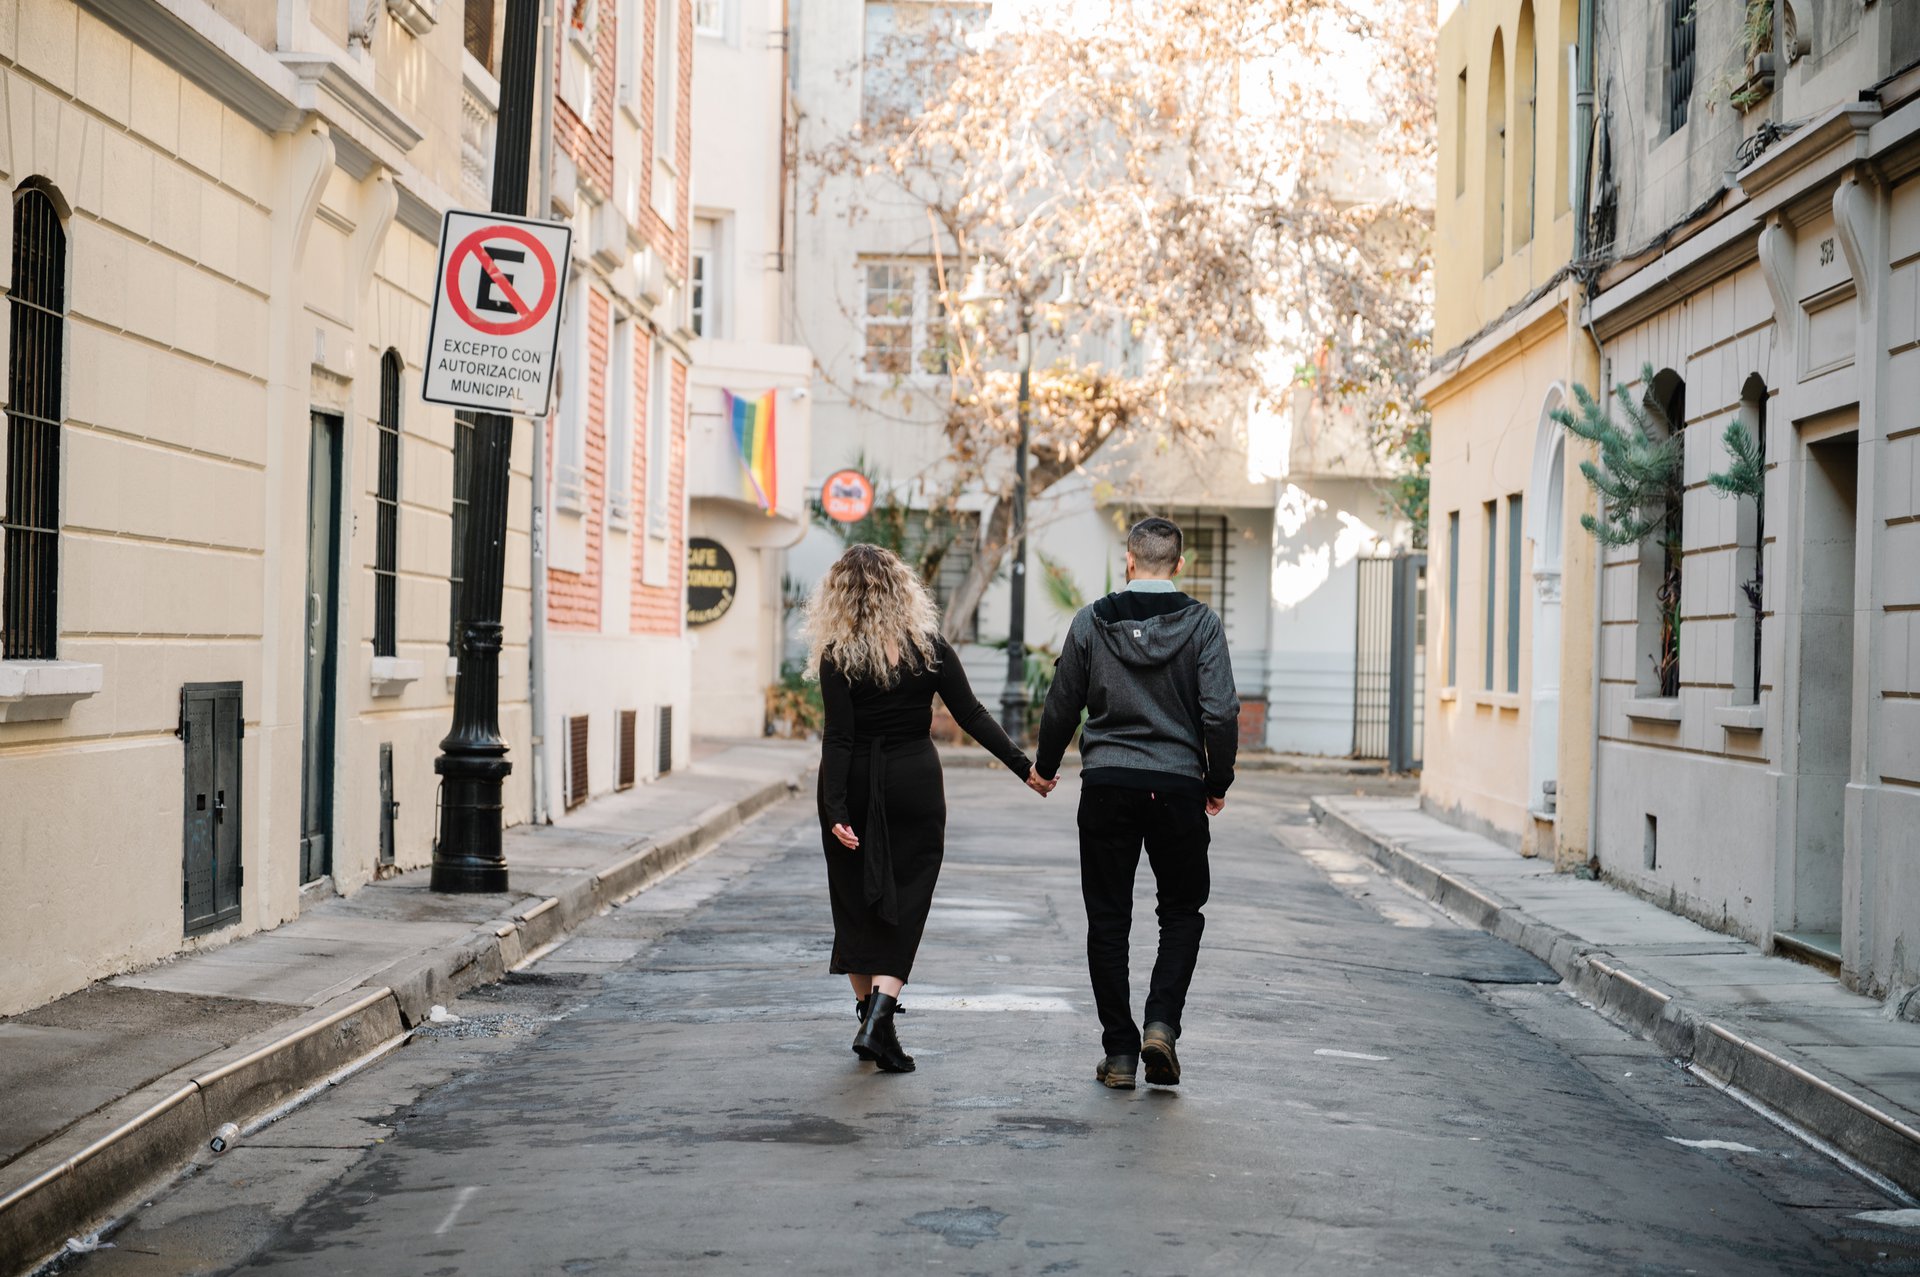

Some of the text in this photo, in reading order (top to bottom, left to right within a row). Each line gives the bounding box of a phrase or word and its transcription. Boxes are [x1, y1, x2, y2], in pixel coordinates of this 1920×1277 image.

[443, 338, 541, 364] EXCEPTO CON
[438, 358, 541, 384] AUTORIZACION
[450, 379, 524, 401] MUNICIPAL
[687, 569, 734, 588] ONDIDO
